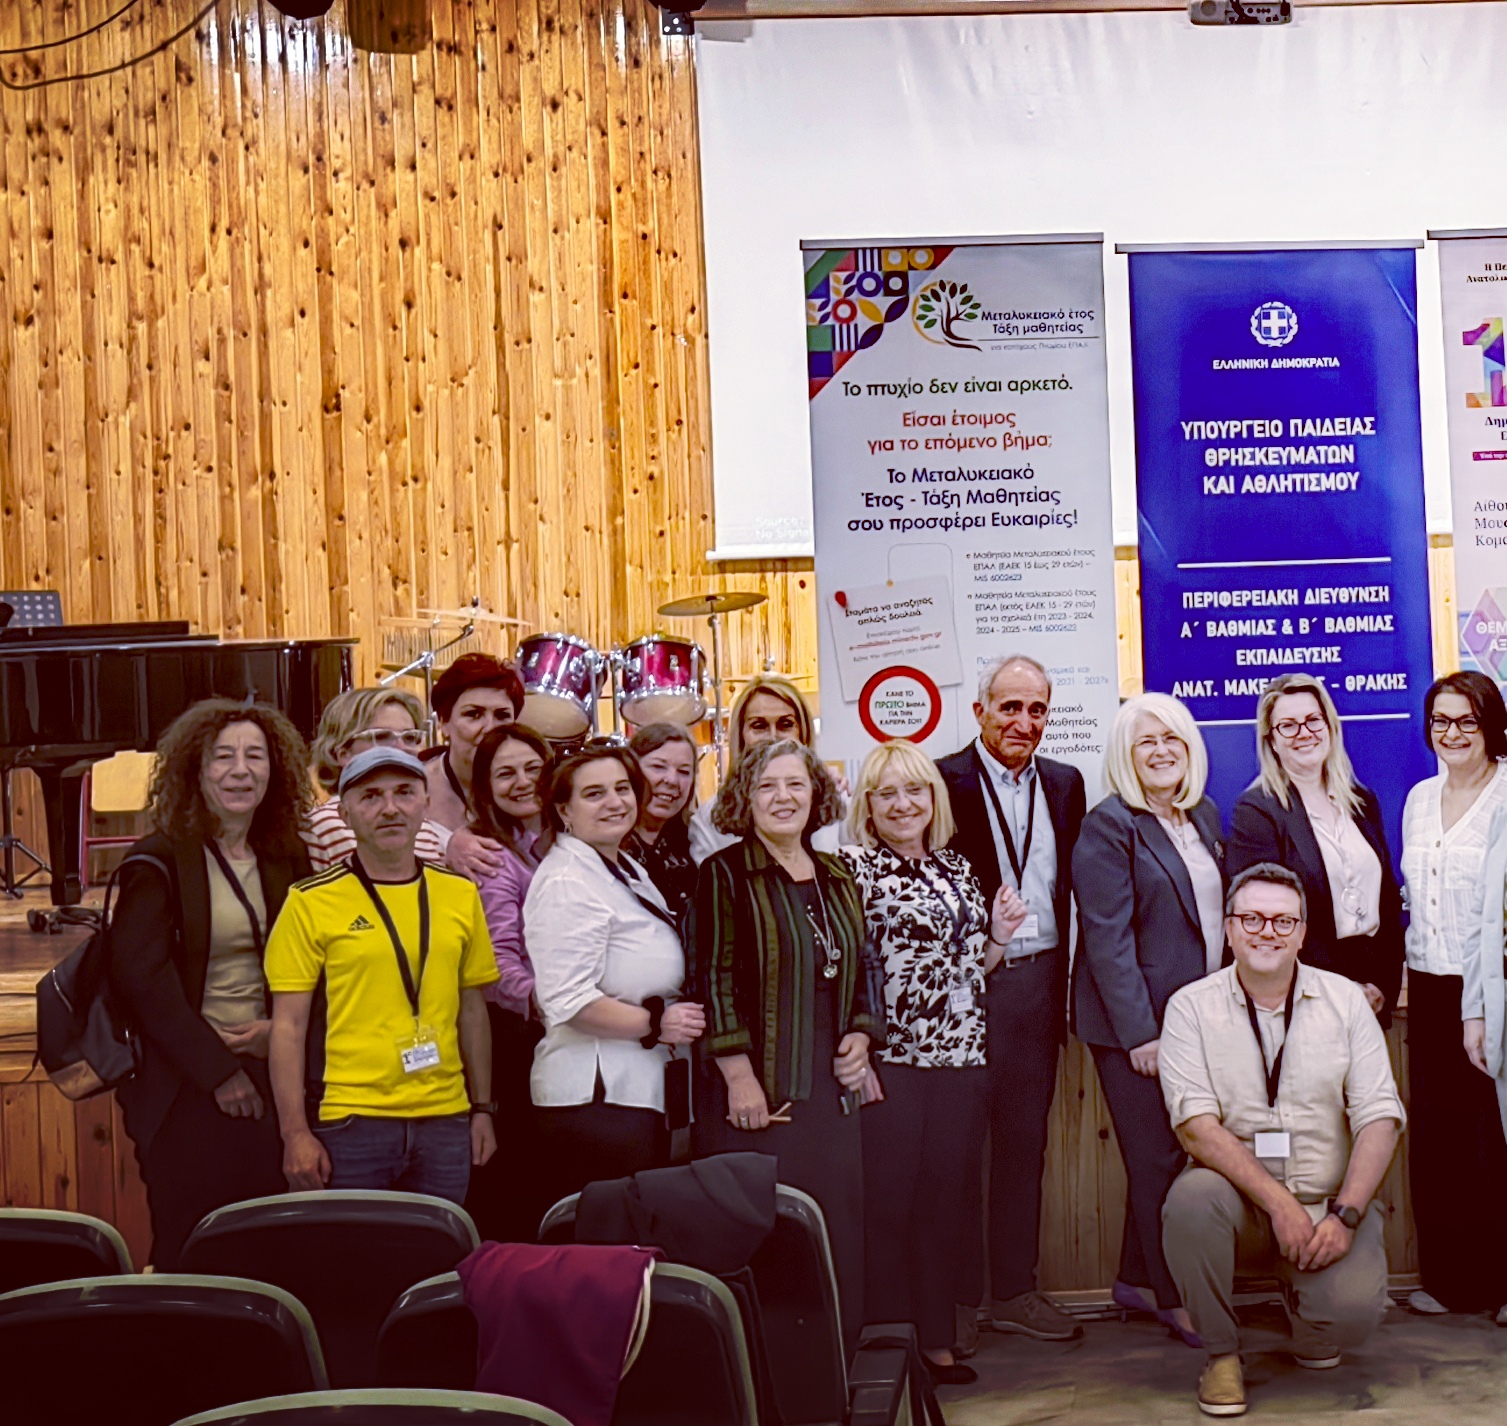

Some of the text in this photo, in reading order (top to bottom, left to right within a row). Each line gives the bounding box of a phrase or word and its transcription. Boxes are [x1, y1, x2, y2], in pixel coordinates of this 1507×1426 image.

[981, 307, 1095, 321] Μεταλυκειακό έτος
[993, 322, 1084, 336] Τάξη μαθητείας
[1213, 357, 1340, 369] ΕΛΛΗΝΙΚΗ ΔΗΜΟΚΡΑΤΙΑ
[842, 374, 1073, 398] Το πτυχίο δεν είναι αρκετό.
[902, 409, 1016, 429] Είσαι έτοιμος
[1180, 417, 1376, 440] ΥΠΟΥΡΓΕΙΟ ΠΑΙΔΕΙΑΣ
[867, 431, 1053, 455] για το επόμενο βήμα;
[1205, 445, 1354, 466] ΘΡΗΣΚΕΥΜΑΤΩΝ
[887, 463, 1034, 483] Το Μεταλυκειακό
[1203, 472, 1359, 494] ΚΑΙ ΑΘΛΗΤΙΣΜΟΥ
[861, 492, 904, 510] Έτος
[922, 488, 961, 508] Τάξη
[966, 487, 1061, 506] Μαθητείας
[847, 510, 1078, 532] σου προσφέρει Ευκαιρίες!
[1182, 586, 1389, 609] ΠΕΡΙΦΕΡΕΙΑΚΗ ΔΙΕΥΘΥΝΣΗ
[1206, 619, 1277, 637] ΒΑΘΜΙΑΣ
[1281, 618, 1293, 635] &
[1325, 615, 1394, 633] ΒΑΘΜΙΑΣ
[1236, 646, 1341, 666] ΕΚΠΑΙΔΕΥΣΗΣ
[1171, 680, 1218, 698] ΑΝΑΤ.
[1345, 673, 1407, 692] ΘΡΑΚΗΣ
[1045, 731, 1091, 740] αυτό που
[1040, 746, 1049, 754] οι
